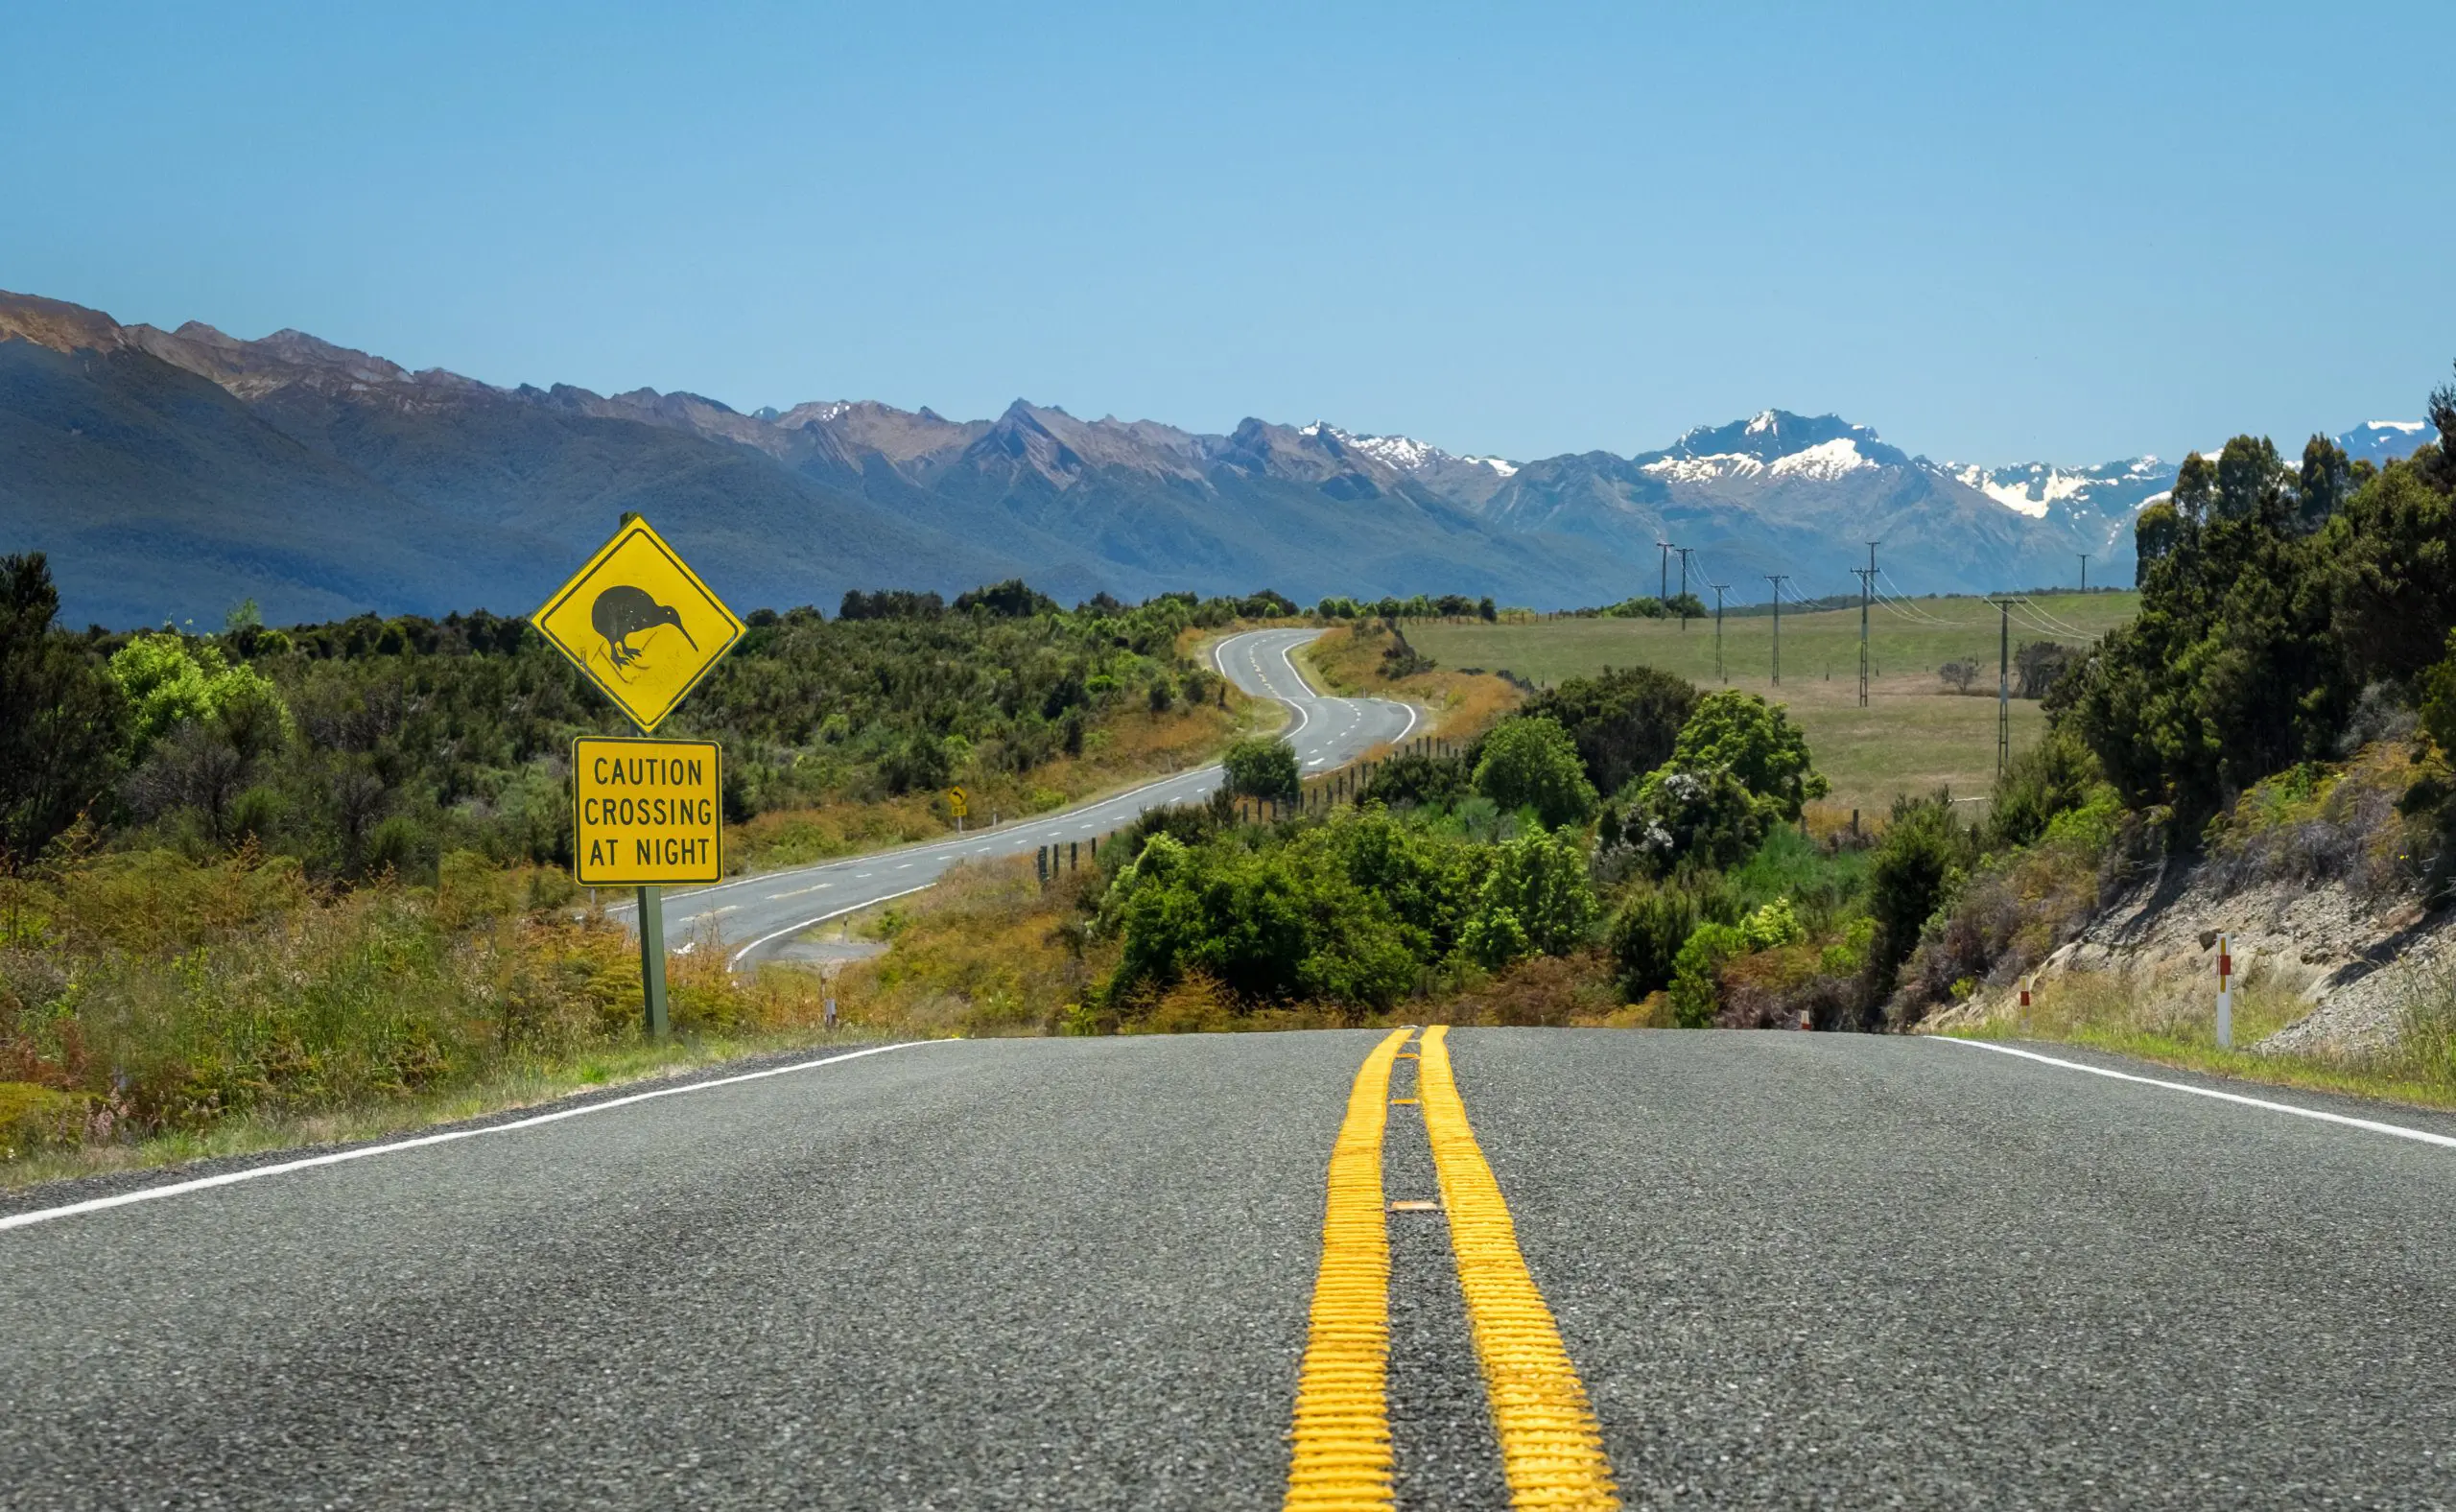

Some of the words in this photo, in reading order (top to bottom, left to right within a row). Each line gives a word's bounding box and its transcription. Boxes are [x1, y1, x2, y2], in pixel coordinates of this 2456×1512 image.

[594, 757, 701, 786] CAUTION
[584, 797, 712, 826] CROSSING
[589, 839, 619, 865] AT
[636, 838, 710, 865] NIGHT
